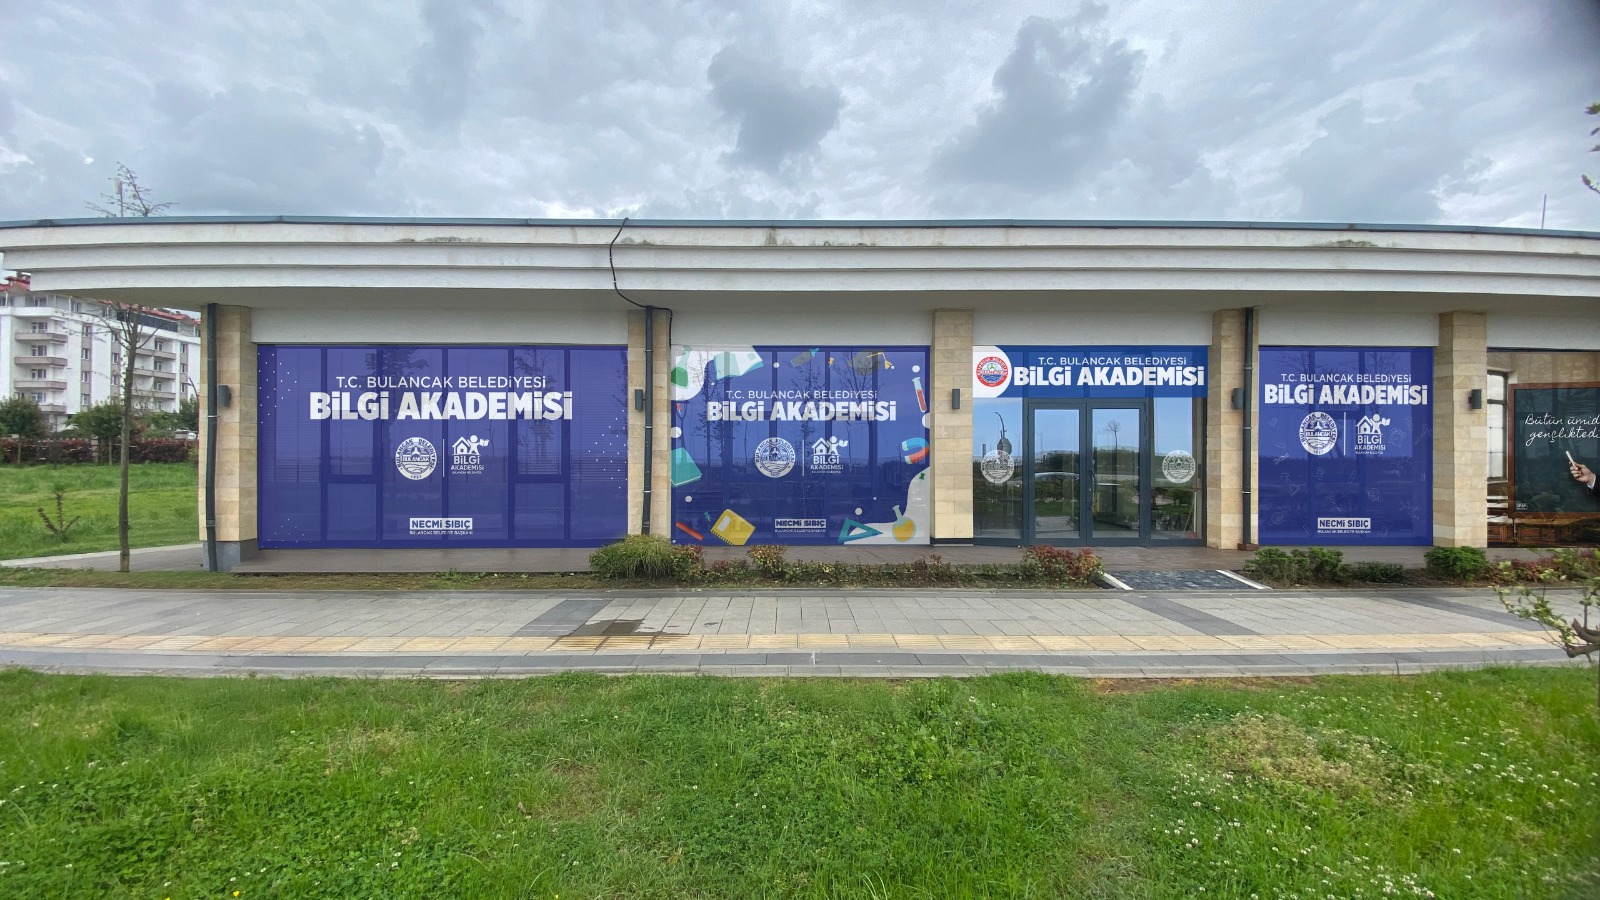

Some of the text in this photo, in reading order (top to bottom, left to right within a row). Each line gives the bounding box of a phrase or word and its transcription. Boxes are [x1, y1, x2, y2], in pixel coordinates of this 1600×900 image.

[1038, 357, 1057, 365] T.C.
[1060, 357, 1121, 366] BULANCAK
[336, 376, 361, 388] T.C.
[367, 376, 453, 388] BULANCAK
[1281, 374, 1297, 382] T.C.
[1300, 374, 1354, 383] BULANCAK
[726, 390, 745, 399] T.C.
[748, 390, 810, 399] BULANCAK
[1525, 412, 1563, 425] Bütün
